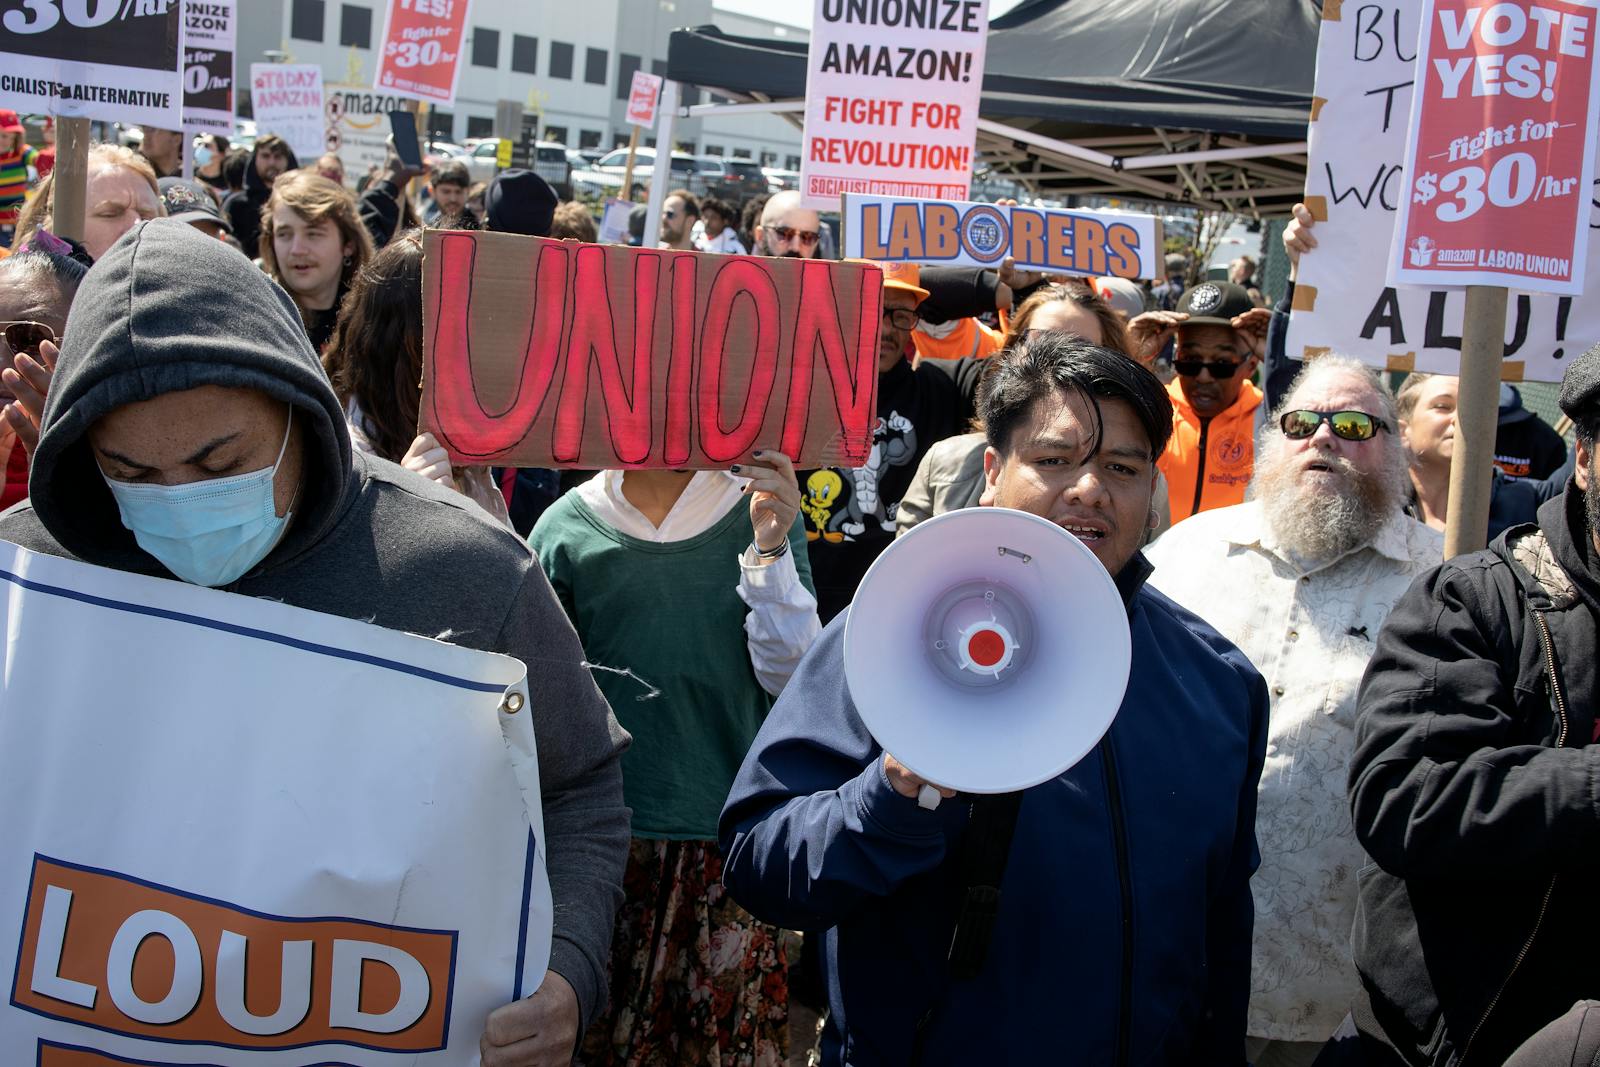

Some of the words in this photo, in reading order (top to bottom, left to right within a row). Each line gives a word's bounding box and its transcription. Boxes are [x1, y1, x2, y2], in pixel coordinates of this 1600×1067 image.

[434, 25, 453, 37] for
[822, 0, 982, 33] UNIONIZE
[1438, 3, 1589, 58] VOTE
[821, 42, 973, 83] AMAZON!
[1433, 54, 1558, 102] YES!
[73, 84, 170, 109] ALTERNATIVE
[824, 96, 903, 127] FIGHT
[911, 102, 962, 130] FOR
[810, 136, 970, 172] REVOLUTION!
[1447, 122, 1517, 163] fight
[1519, 118, 1560, 142] for
[1413, 152, 1578, 222] $30/hr
[860, 203, 1143, 279] LABORERS
[1437, 249, 1475, 263] amazon
[1478, 248, 1526, 271] LABOR
[1526, 254, 1570, 277] UNION
[432, 233, 883, 464] UNION
[30, 884, 432, 1036] LOUD
